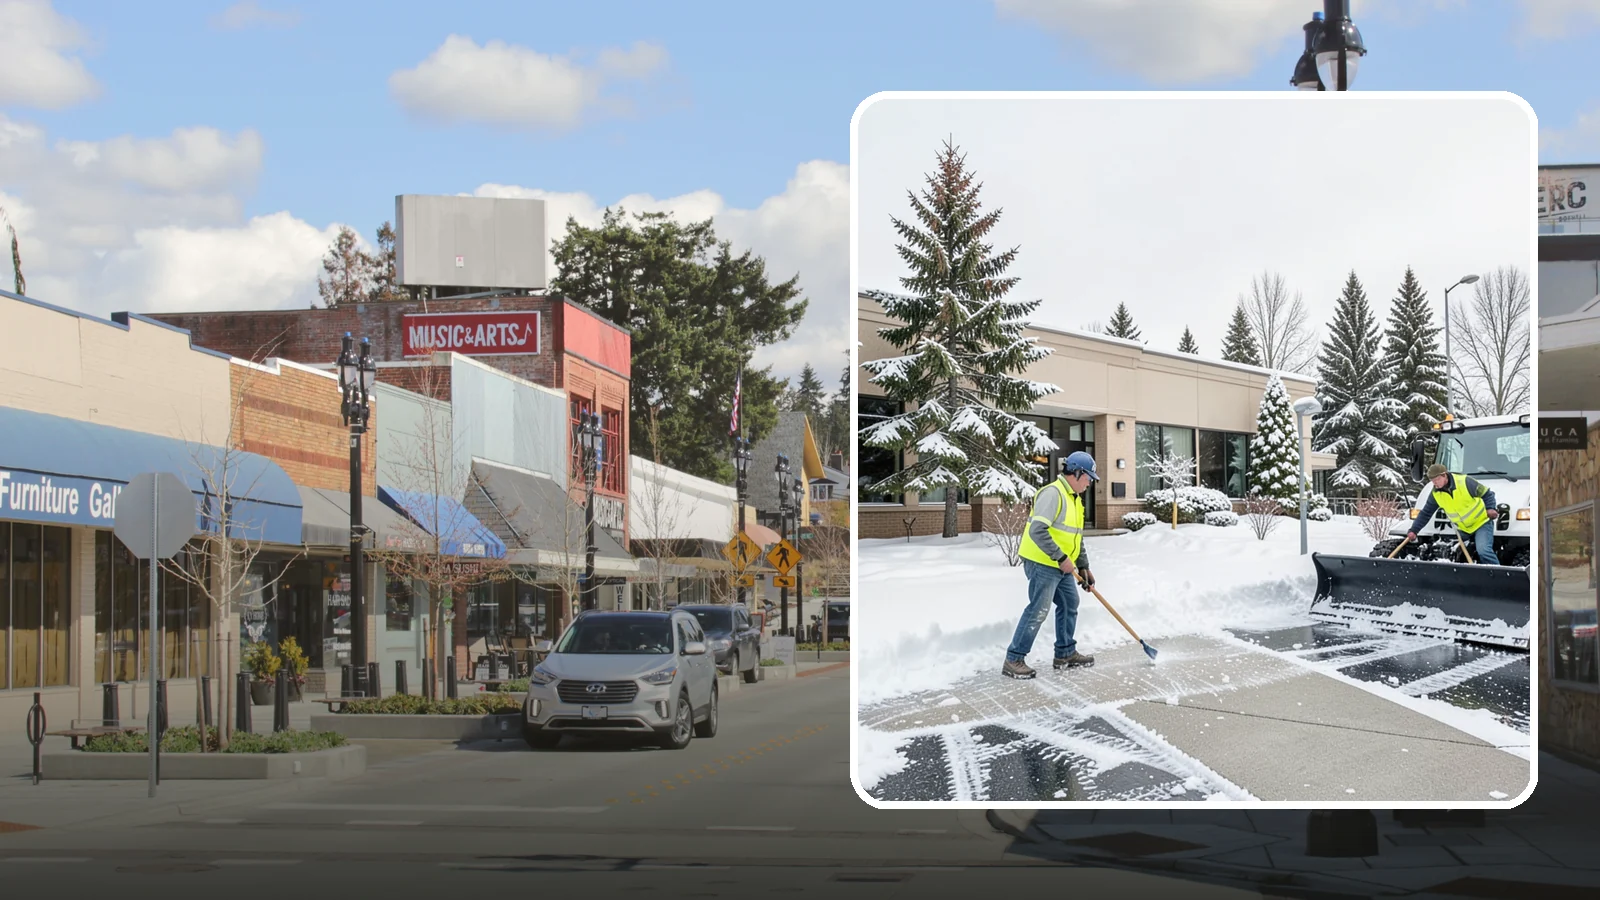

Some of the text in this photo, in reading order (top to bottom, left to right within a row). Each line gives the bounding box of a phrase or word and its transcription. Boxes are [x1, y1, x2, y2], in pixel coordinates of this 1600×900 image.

[1540, 427, 1578, 437] UGA
[0, 471, 122, 519] Furniture Gal
[453, 563, 479, 574] SUSHI
